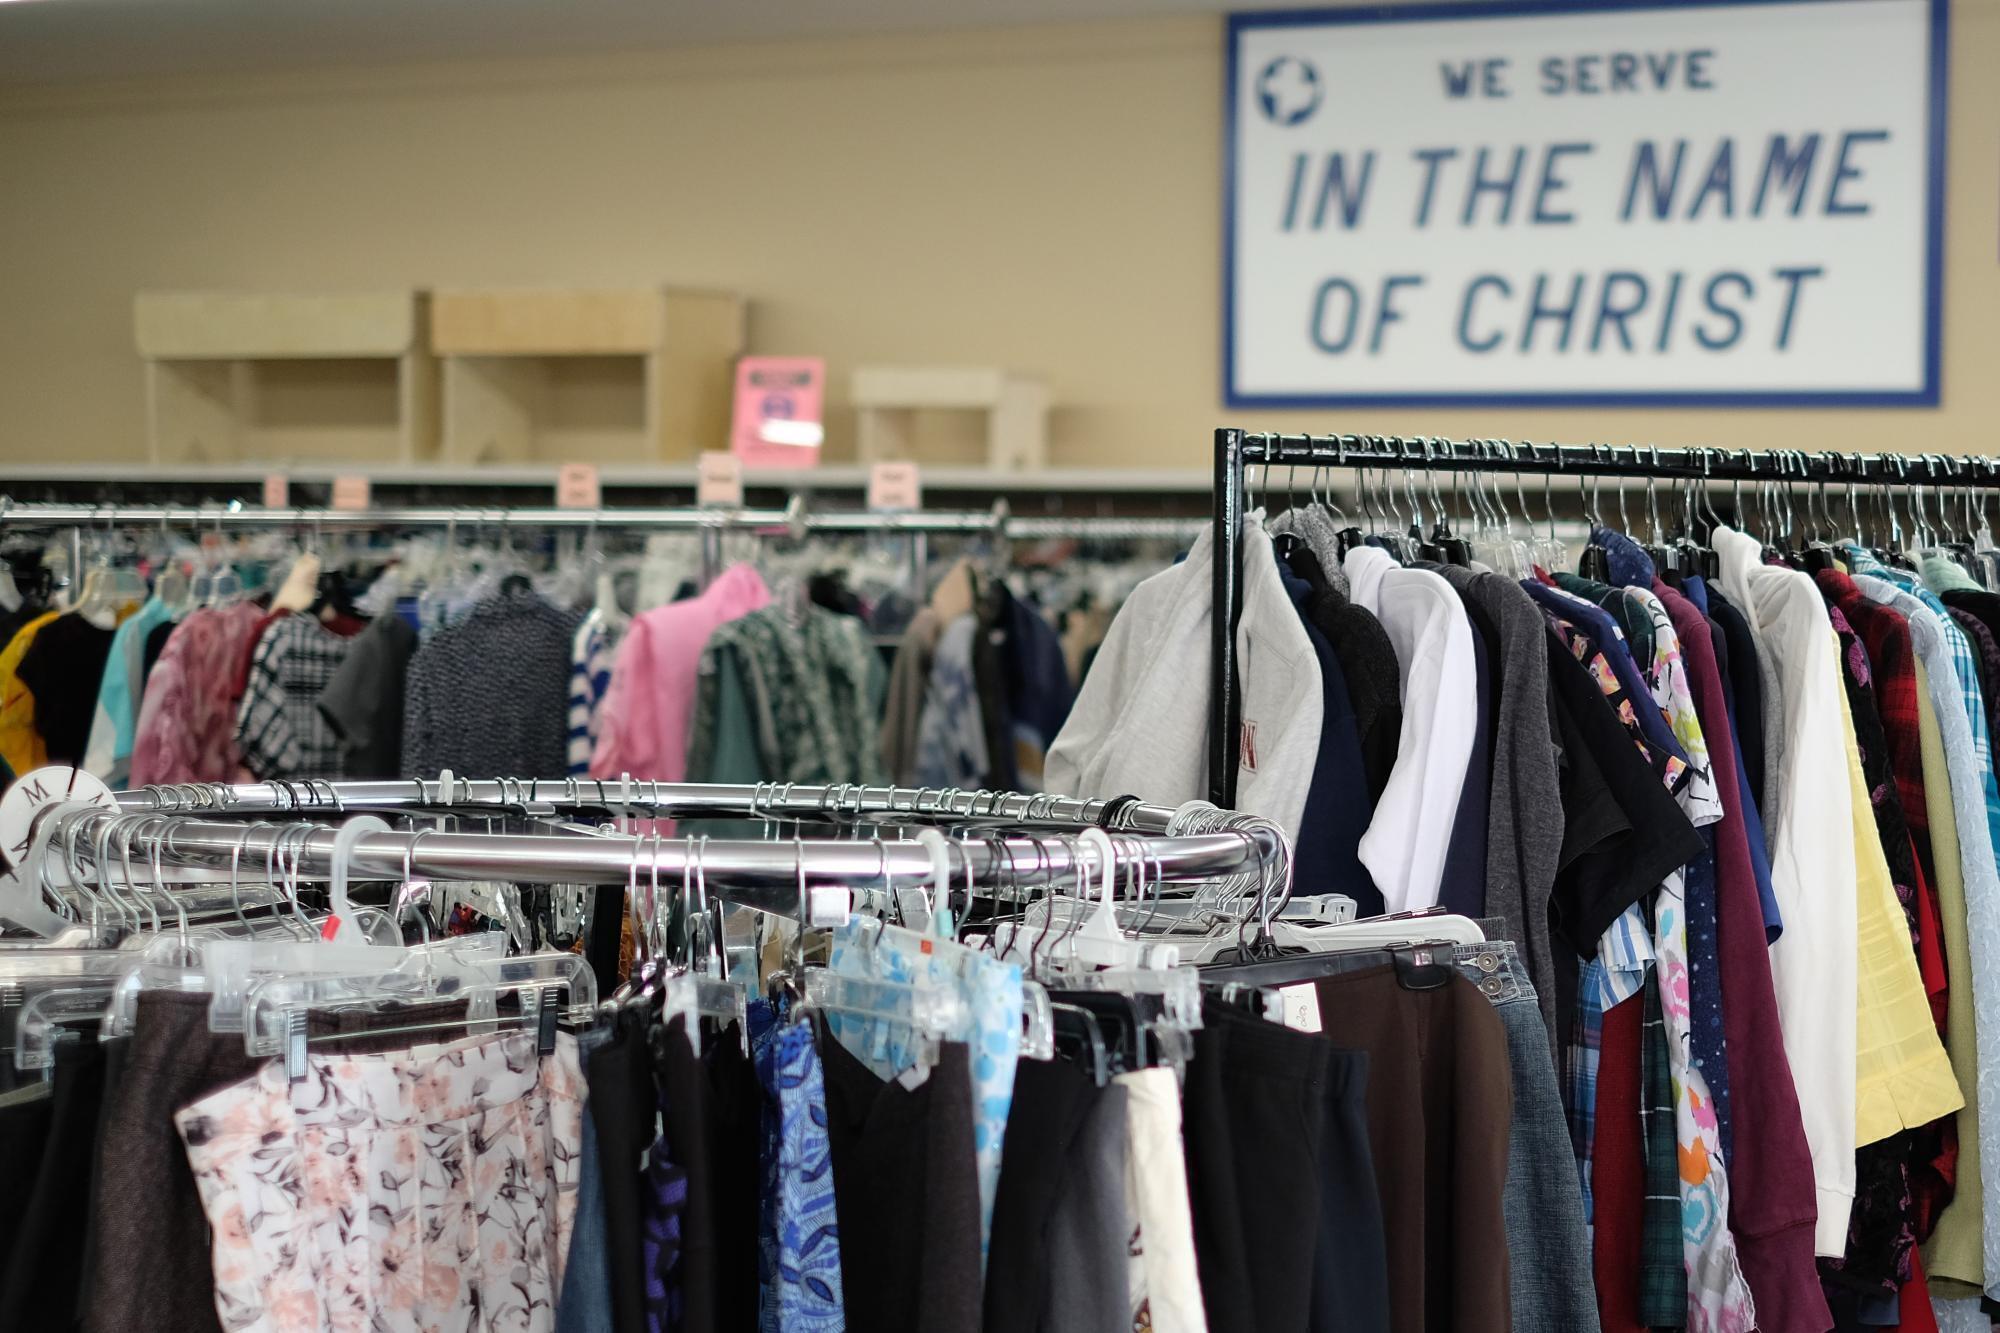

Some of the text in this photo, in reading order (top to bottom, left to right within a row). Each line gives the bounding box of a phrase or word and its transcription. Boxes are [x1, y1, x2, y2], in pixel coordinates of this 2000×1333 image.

[1439, 49, 1717, 100] WE SERVE
[1279, 128, 1893, 232] IN THE NAME
[1307, 265, 1827, 357] OF CHRIST
[21, 777, 51, 807] M
